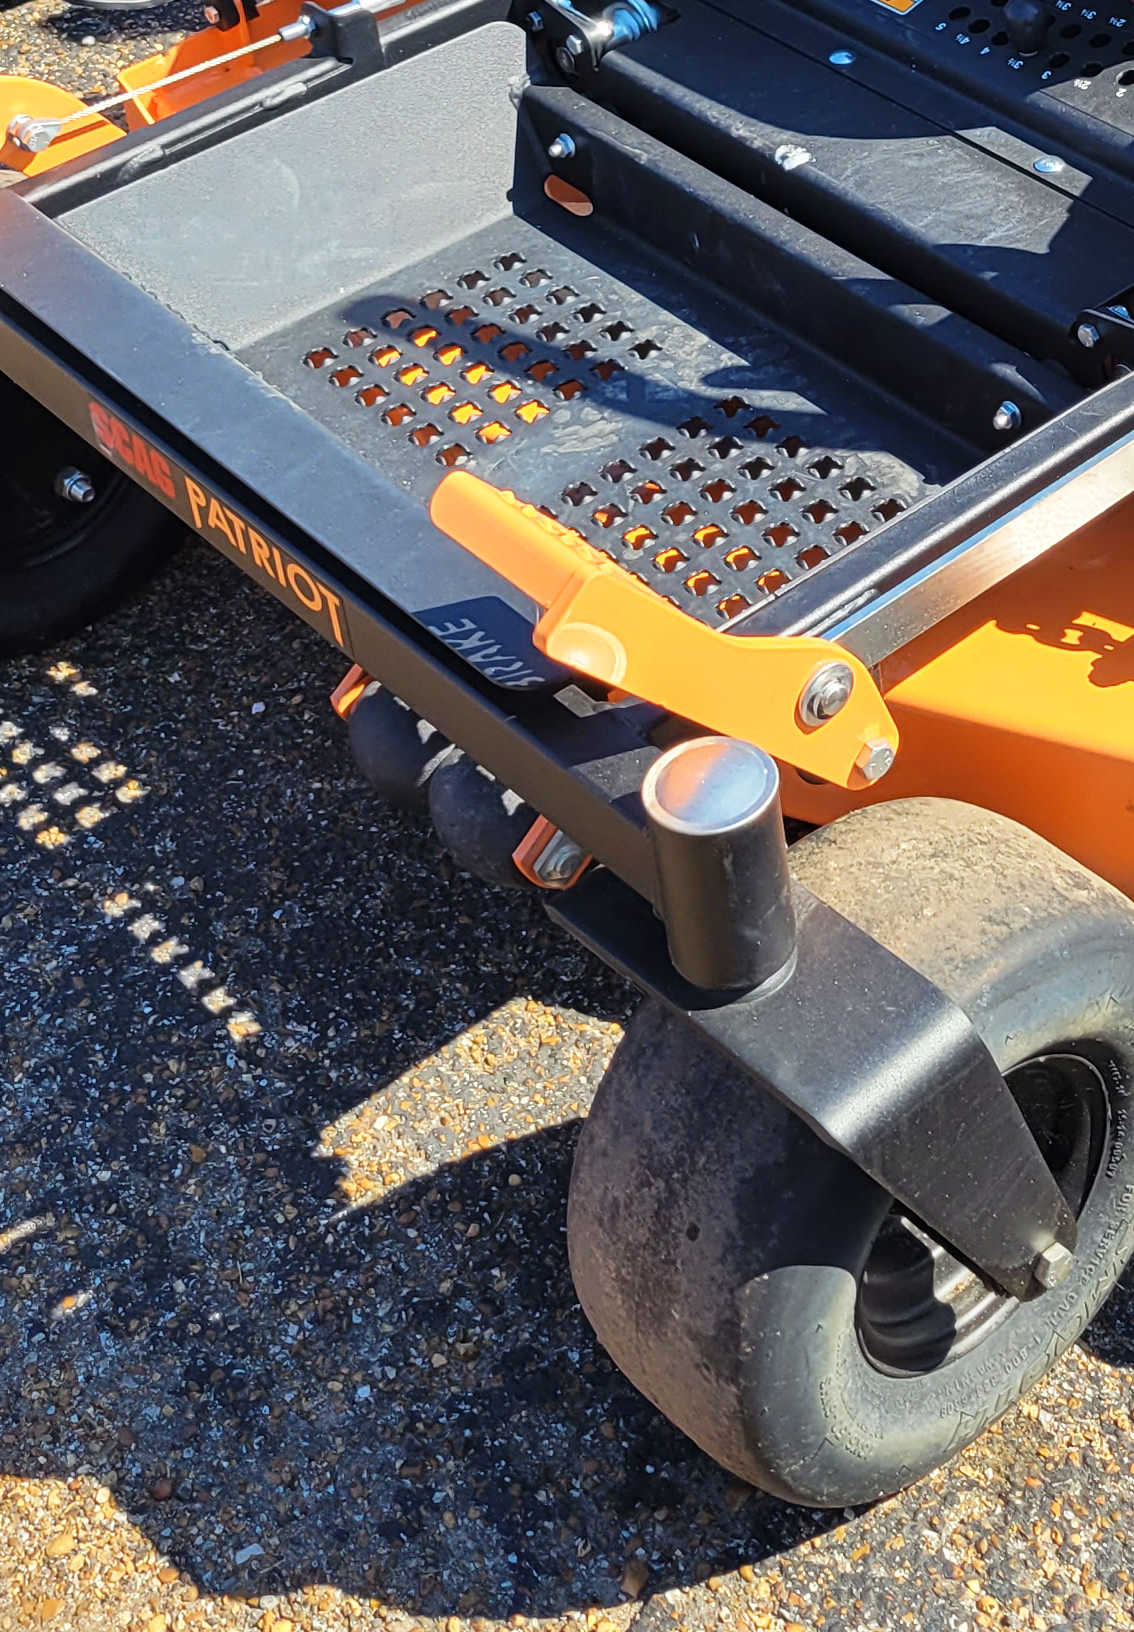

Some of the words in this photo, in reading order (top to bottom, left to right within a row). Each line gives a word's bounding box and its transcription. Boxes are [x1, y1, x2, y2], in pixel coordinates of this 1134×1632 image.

[935, 22, 947, 32] 5
[979, 46, 991, 56] 4
[1041, 70, 1052, 79] 3
[1115, 88, 1127, 98] 2
[88, 401, 176, 499] SCAG
[184, 474, 344, 648] PATRIOT
